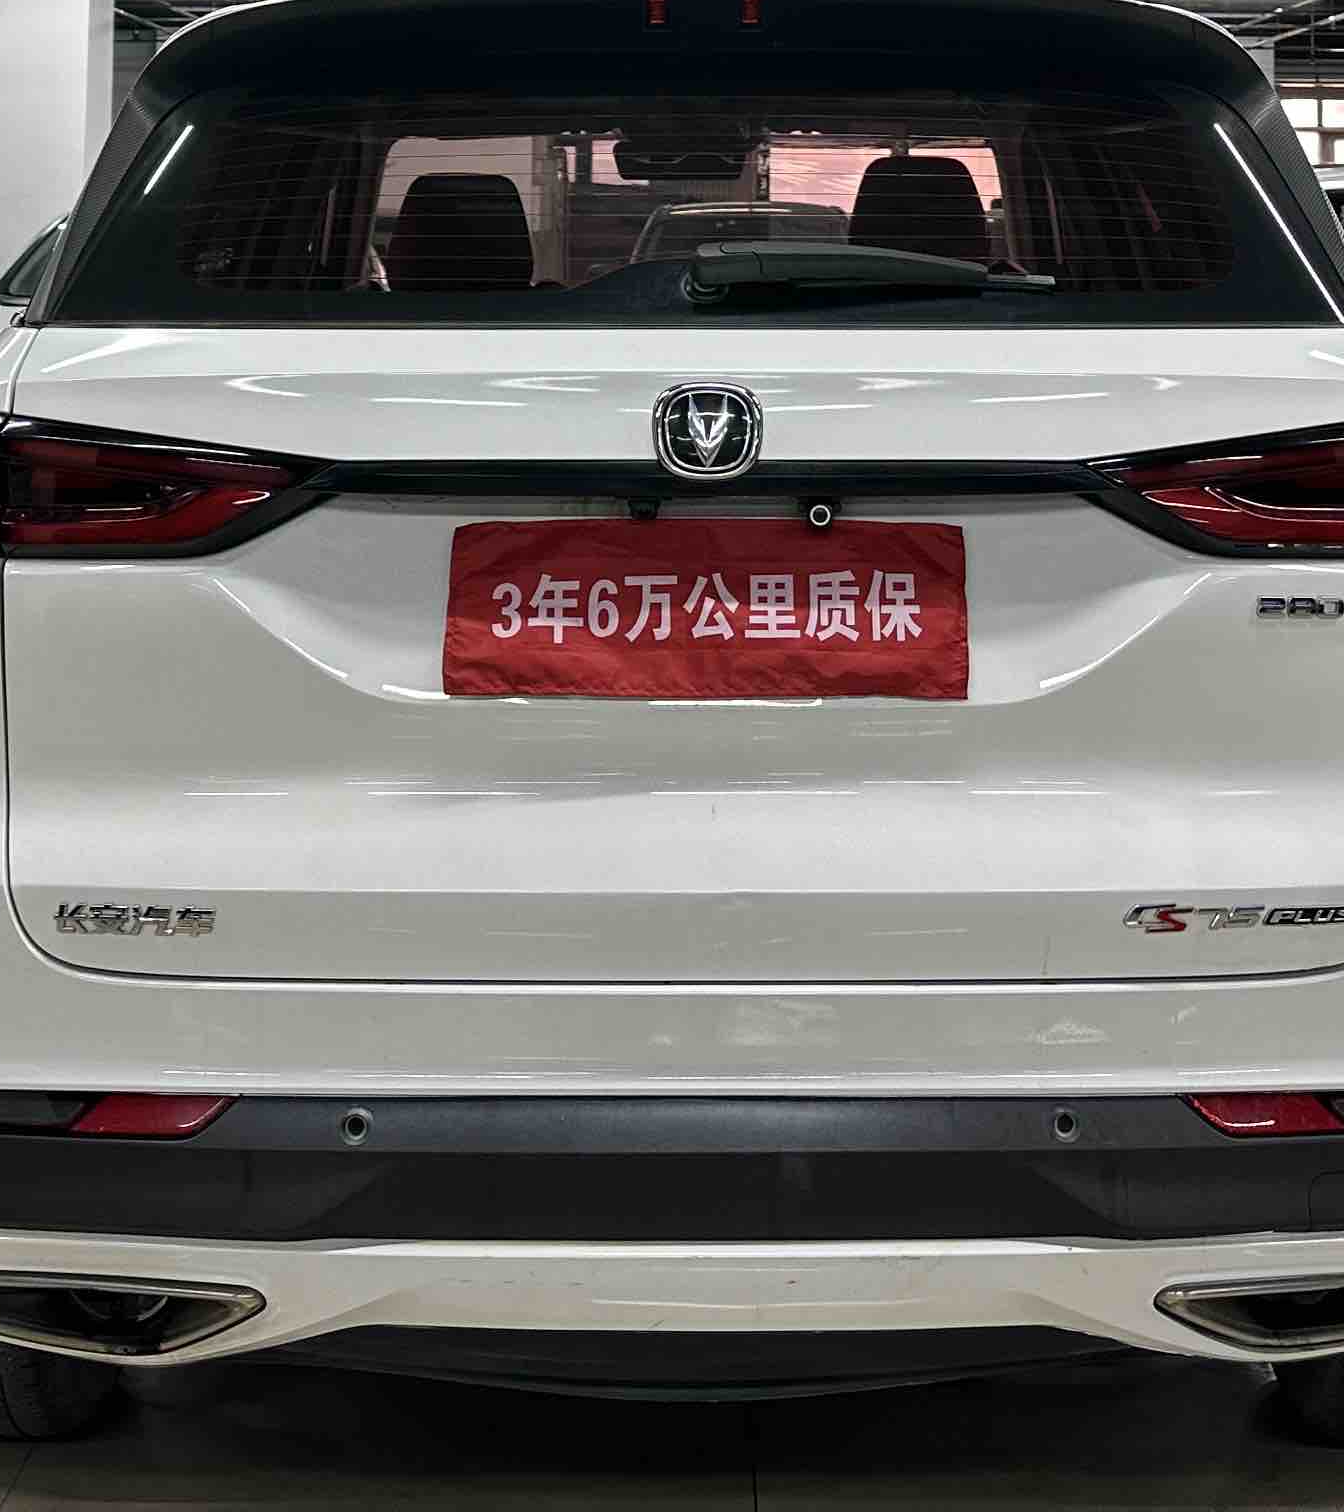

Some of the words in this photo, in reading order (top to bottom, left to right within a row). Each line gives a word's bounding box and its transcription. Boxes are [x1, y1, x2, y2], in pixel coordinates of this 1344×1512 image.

[490, 570, 923, 645] 3年6万公里质保
[54, 903, 217, 937] 长安汽车
[1123, 904, 1265, 933] CS75
